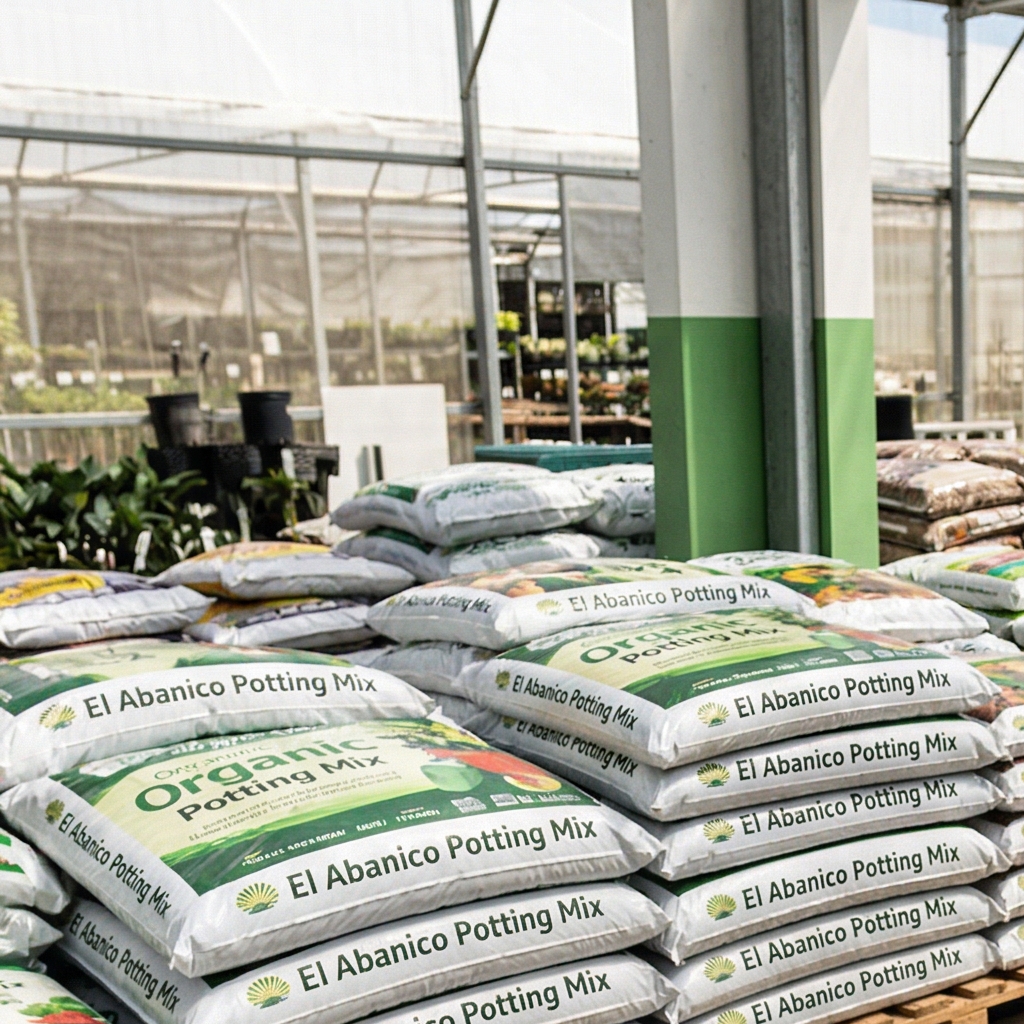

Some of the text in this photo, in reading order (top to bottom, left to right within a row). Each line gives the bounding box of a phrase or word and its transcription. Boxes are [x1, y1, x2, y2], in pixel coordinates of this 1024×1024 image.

[567, 581, 771, 612] El Abanico Potting Mix
[82, 673, 378, 719] El Abanico Potting Mix
[512, 675, 638, 730] El Abanico Potting Mix
[734, 668, 951, 719] El Abanico Potting Mix
[135, 737, 379, 812] Organic
[176, 768, 317, 822] Potting
[317, 754, 388, 774] Mix
[613, 753, 638, 777] Mix
[736, 731, 958, 782] El Abanico Potting Mix
[739, 778, 958, 836] El Abanico Potting Mix
[58, 813, 172, 919] El Abanico Potting Mix
[286, 869, 318, 900] El
[326, 845, 440, 891] Abanico
[449, 820, 547, 860] Potting
[550, 816, 598, 841] Mix
[742, 842, 961, 911] El Abanico Potting Mix
[68, 912, 181, 1014] El Abanico Potting Mix
[297, 895, 605, 993] El Abanico Potting Mix
[739, 896, 958, 971] El Abanico Potting Mix
[563, 970, 611, 998] Mix
[778, 978, 856, 1019] Abanico
[860, 958, 928, 992] Potting
[930, 947, 963, 968] Mix
